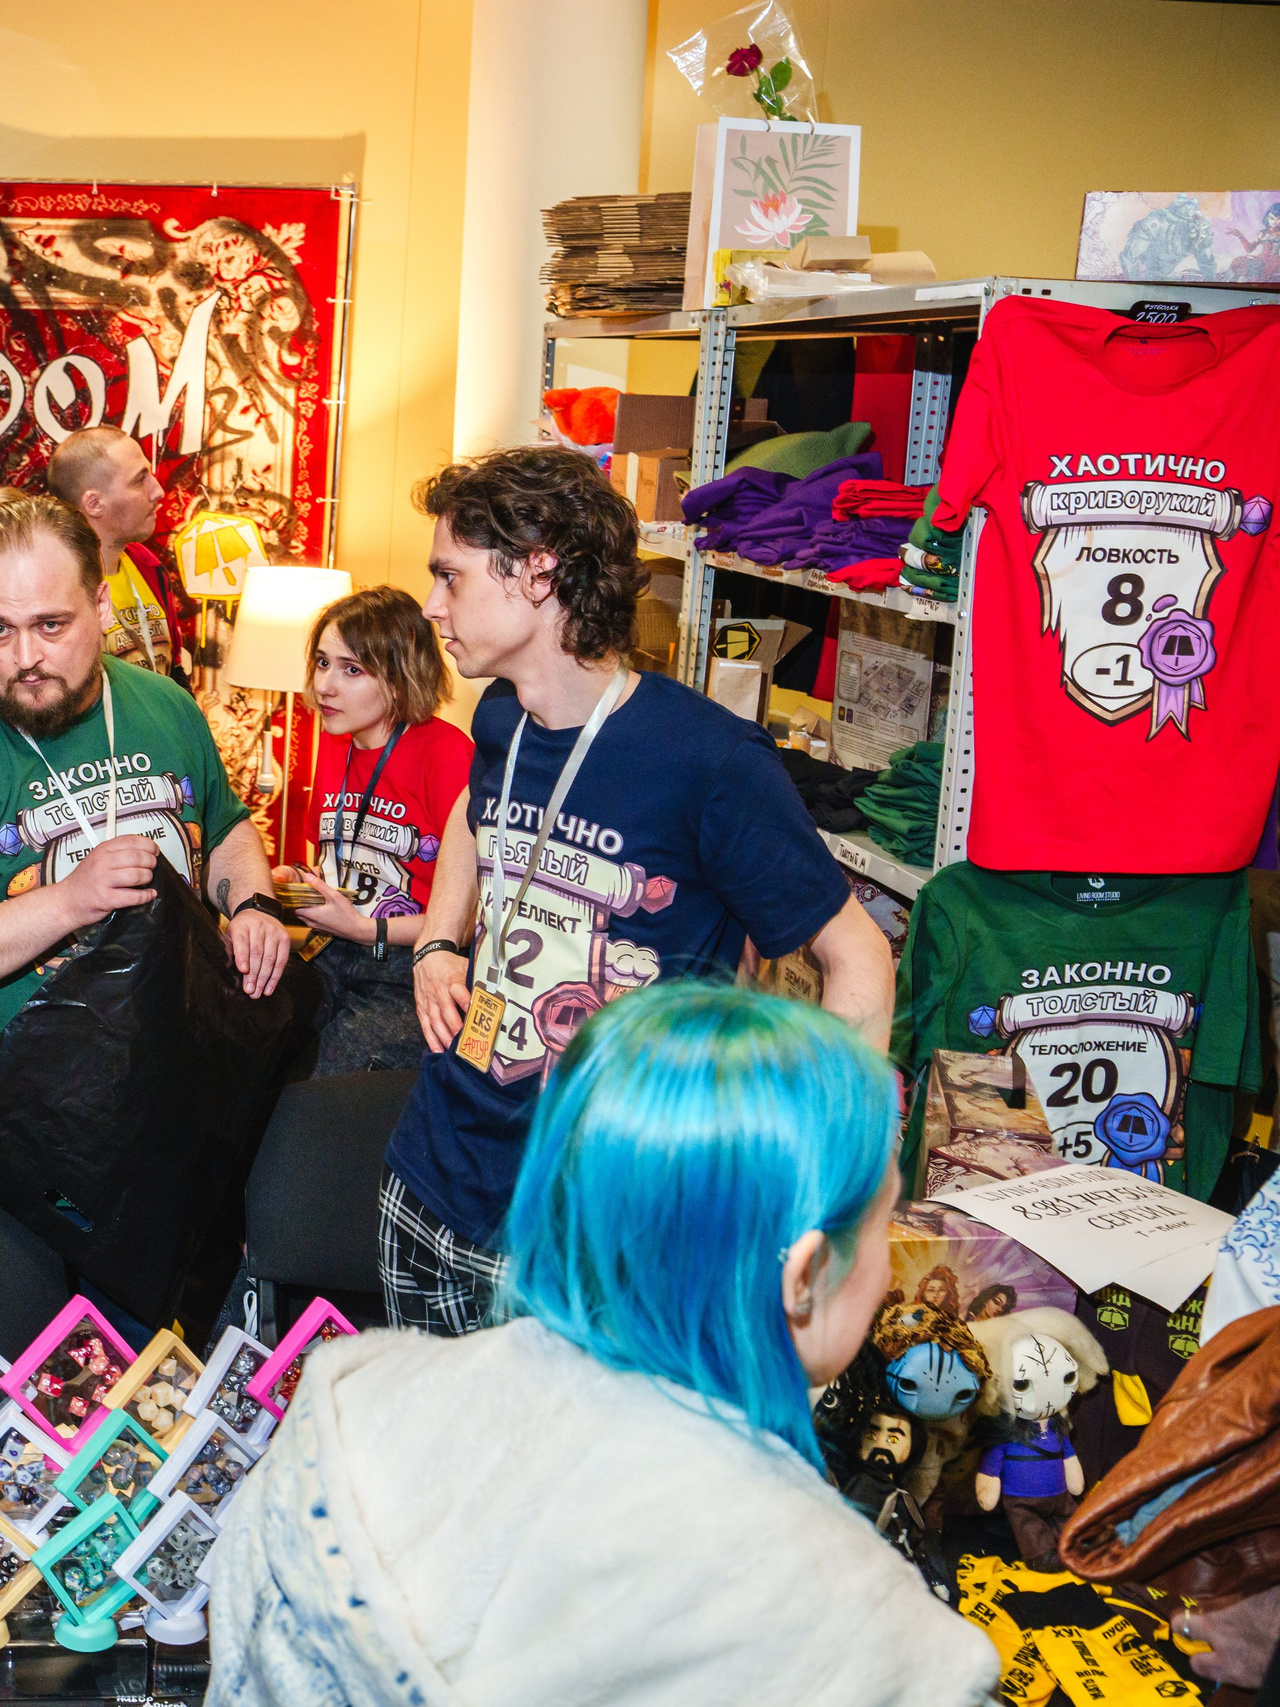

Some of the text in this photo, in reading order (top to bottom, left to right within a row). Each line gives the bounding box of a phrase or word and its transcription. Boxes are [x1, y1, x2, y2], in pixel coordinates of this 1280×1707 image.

[1049, 453, 1226, 482] ХАОТИЧНО
[1051, 487, 1216, 517] криворукий
[1076, 546, 1180, 564] ЛОВКОСТЬ
[1101, 573, 1146, 626] 8
[110, 603, 161, 625] АКОННО
[1095, 653, 1135, 686] -1
[29, 752, 151, 801] ЗАКОННО
[322, 793, 406, 819] ХОТЧНО
[321, 816, 399, 843] крврукий
[340, 859, 381, 875] ОВКОСТЬ
[353, 873, 379, 905] 8
[504, 928, 544, 989] 2
[1021, 961, 1172, 989] ЗАКОННО
[1027, 989, 1158, 1018] ТОЛСТЫЙ
[473, 1010, 493, 1032] LRS
[461, 1036, 490, 1061] АРТУР
[1029, 1040, 1147, 1056] ТЕЛОСЛОЖЕНИЕ
[1046, 1058, 1119, 1108] 20
[1058, 1131, 1093, 1159] +5
[1012, 1205, 1043, 1220] 8
[1032, 1197, 1084, 1216] 981
